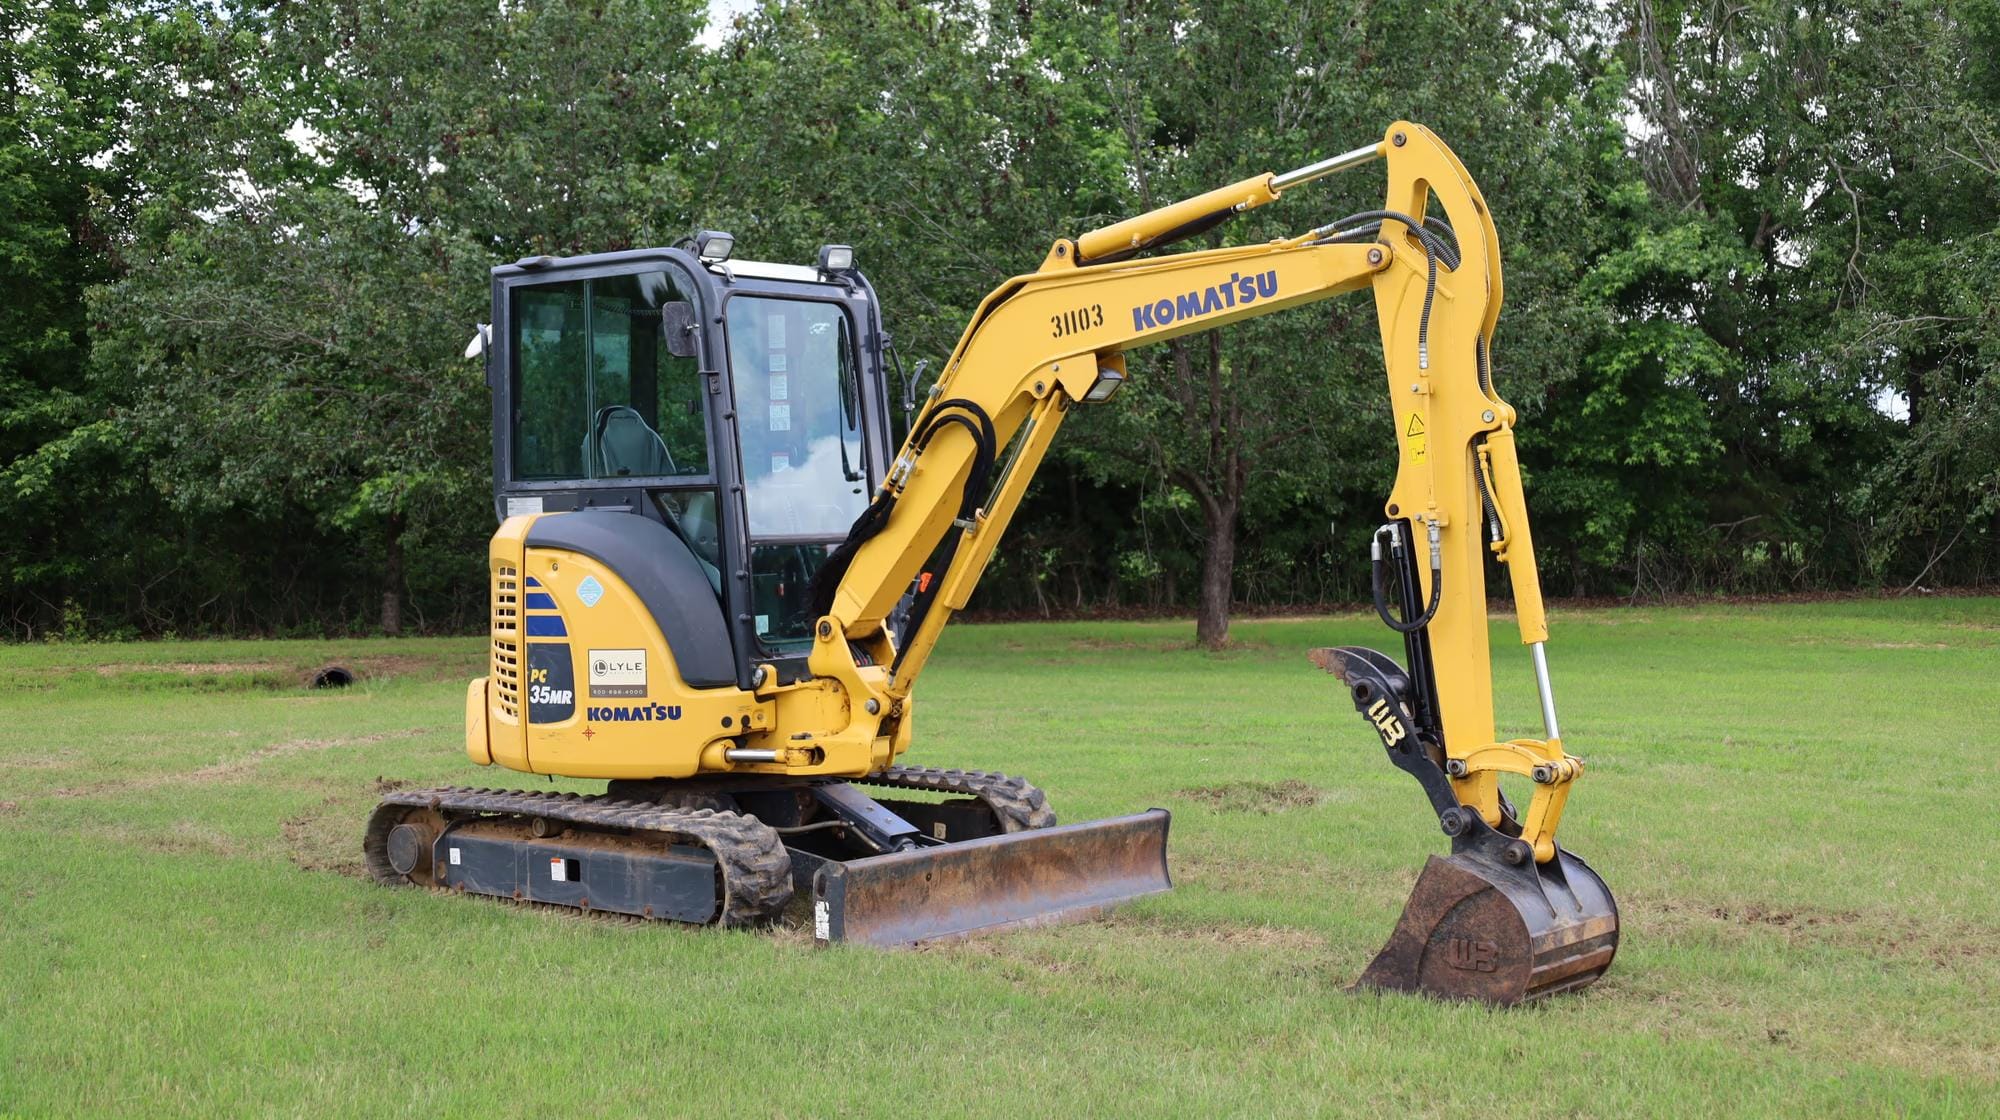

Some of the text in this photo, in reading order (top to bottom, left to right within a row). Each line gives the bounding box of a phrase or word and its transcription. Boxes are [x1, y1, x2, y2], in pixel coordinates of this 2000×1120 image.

[1132, 270, 1278, 332] KOMATSU
[1051, 304, 1104, 338] 31103
[609, 662, 642, 671] LYLE
[530, 669, 547, 683] PC
[530, 686, 573, 704] 35MR
[587, 702, 682, 721] KOMATSU
